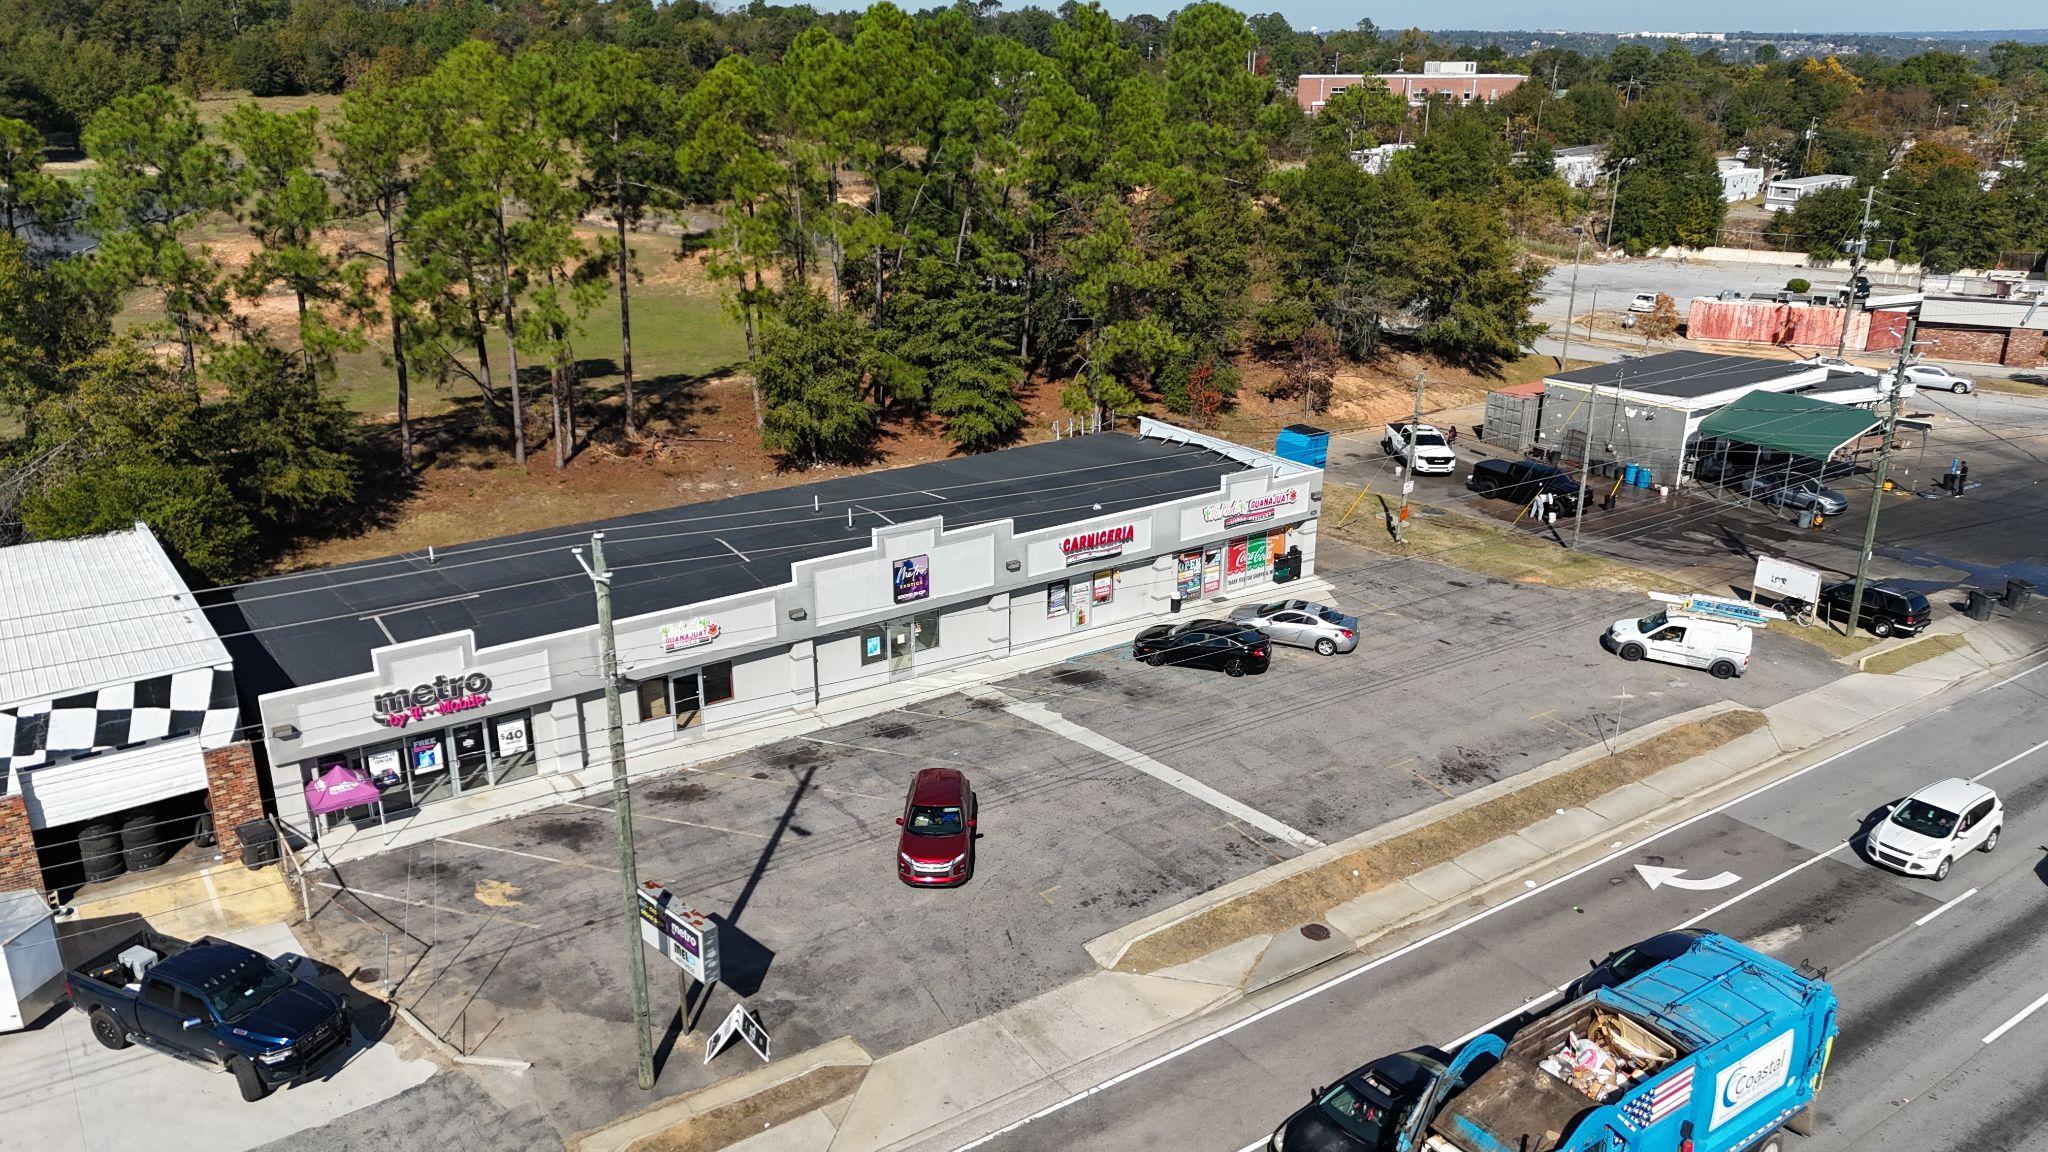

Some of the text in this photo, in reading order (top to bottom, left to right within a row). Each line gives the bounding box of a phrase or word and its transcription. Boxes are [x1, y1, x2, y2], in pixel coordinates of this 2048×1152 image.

[1063, 525, 1134, 553] CARNICERIA
[373, 672, 492, 713] metro
[387, 712, 409, 728] by
[413, 737, 437, 748] FREE
[500, 729, 524, 741] $40
[671, 922, 697, 947] metro
[1735, 1049, 1786, 1095] Coastal
